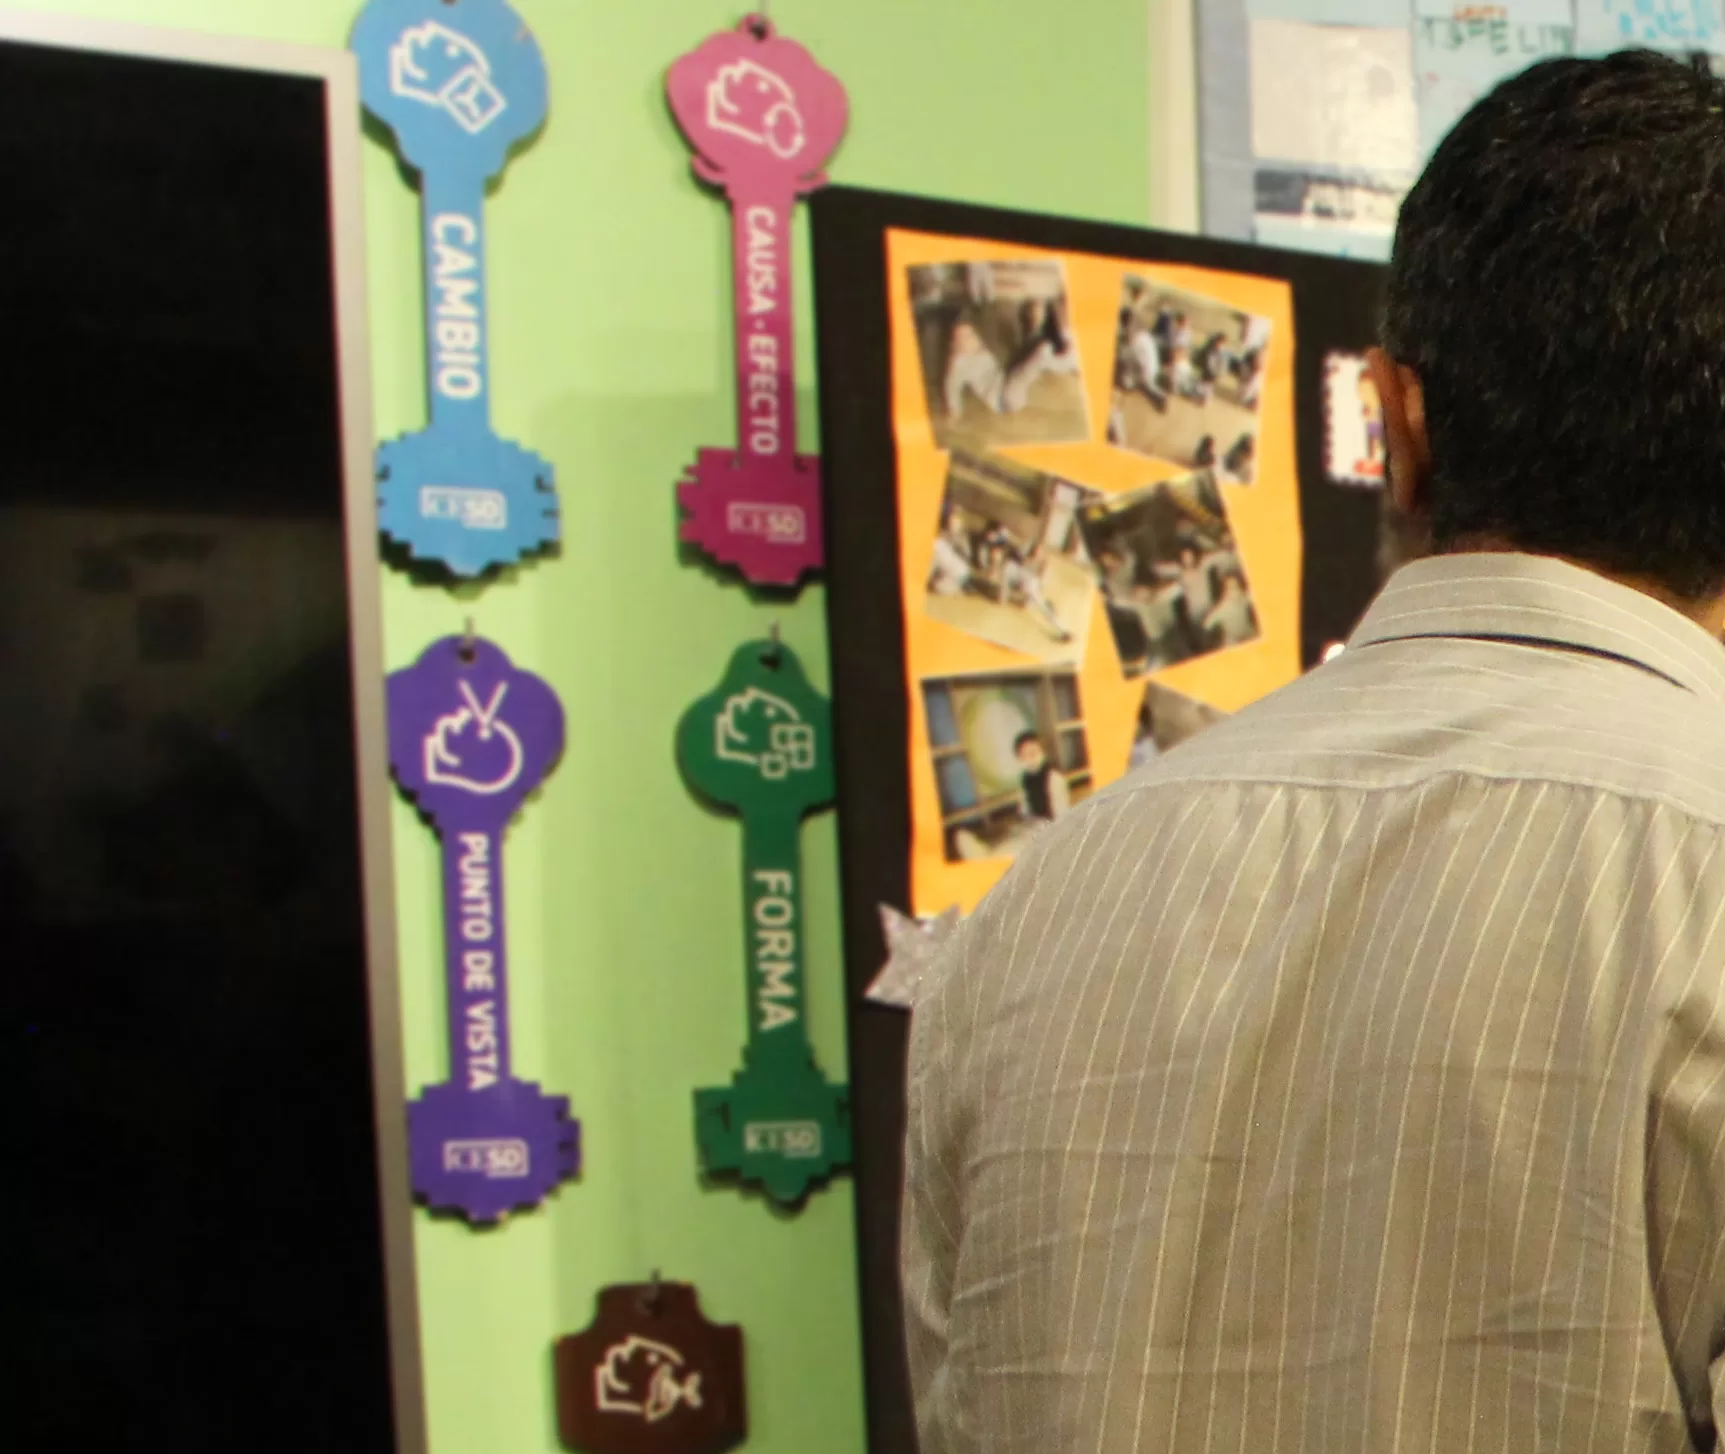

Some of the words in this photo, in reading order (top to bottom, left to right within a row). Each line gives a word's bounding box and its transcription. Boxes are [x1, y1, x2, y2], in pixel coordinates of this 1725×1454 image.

[430, 214, 483, 400] CAMBIO
[458, 832, 491, 941] PUNTO
[463, 951, 493, 990] DE
[753, 869, 797, 1032] FORMA
[467, 1001, 498, 1091] VISTA
